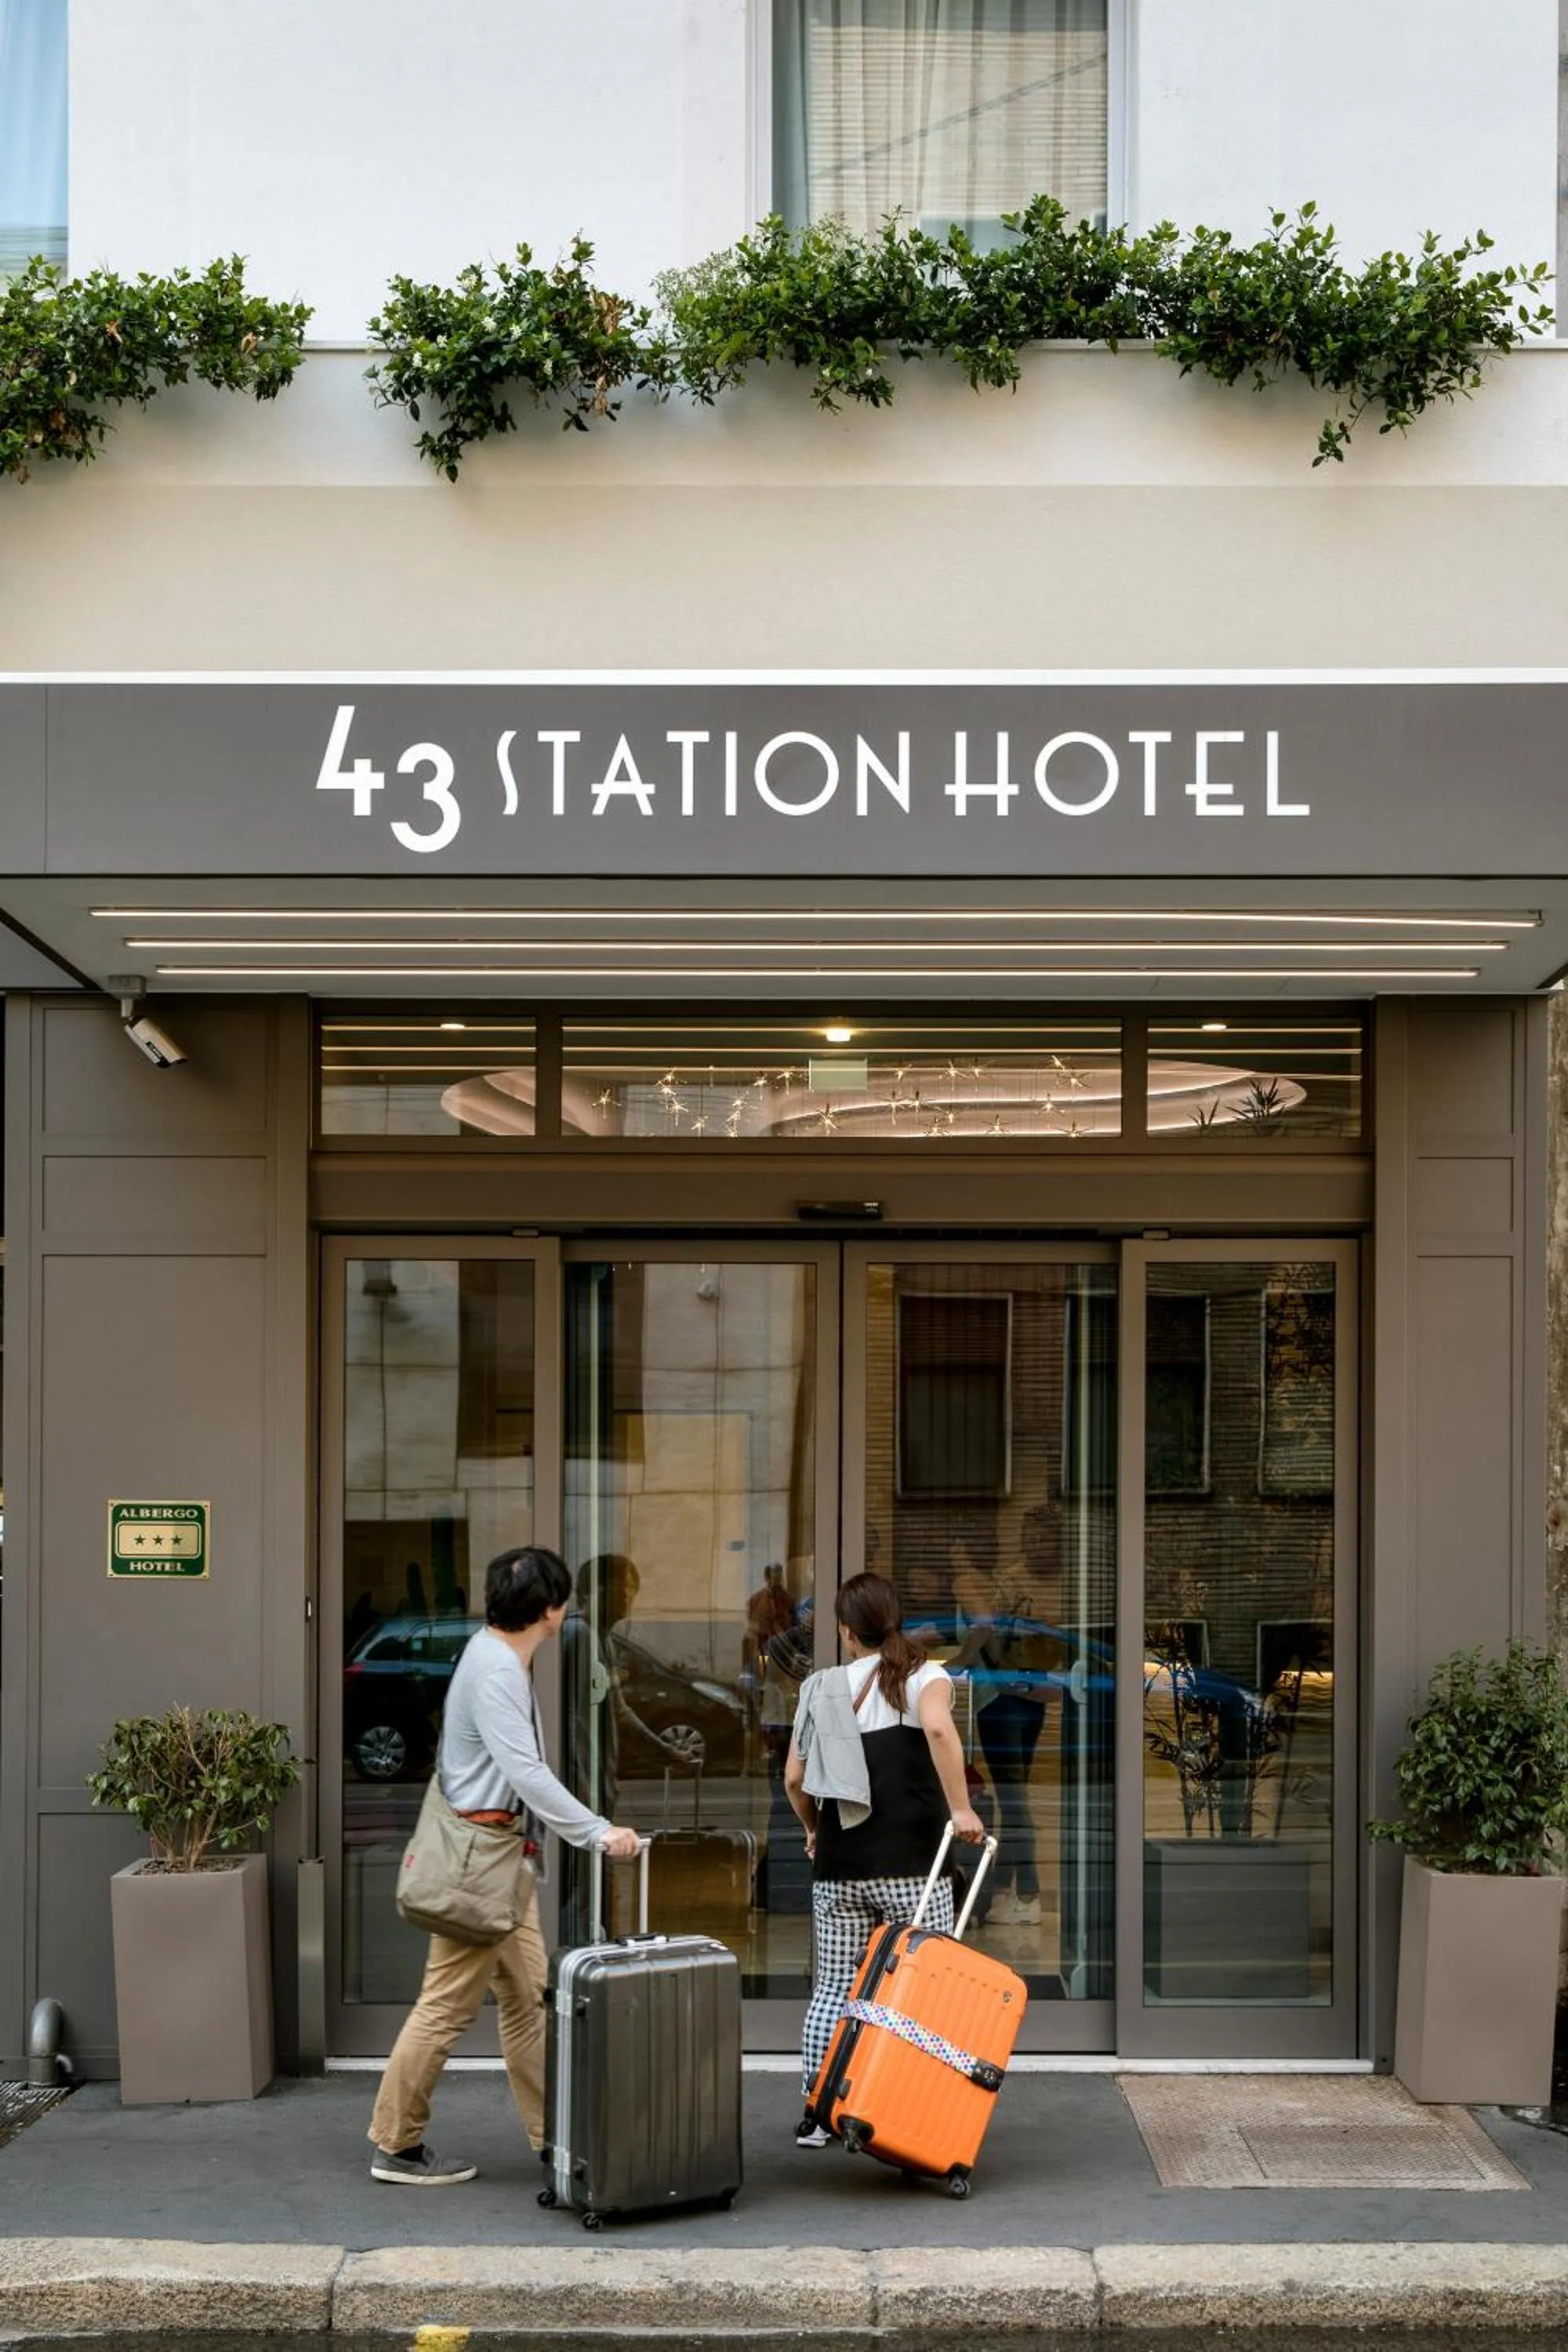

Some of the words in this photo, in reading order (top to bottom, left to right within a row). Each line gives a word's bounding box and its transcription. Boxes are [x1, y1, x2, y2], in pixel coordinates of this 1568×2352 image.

[315, 705, 461, 853] 43
[496, 730, 910, 816] STATION
[944, 731, 1310, 816] HOTEL
[120, 1508, 198, 1519] ALBERGO
[129, 1561, 185, 1572] HOTEL
